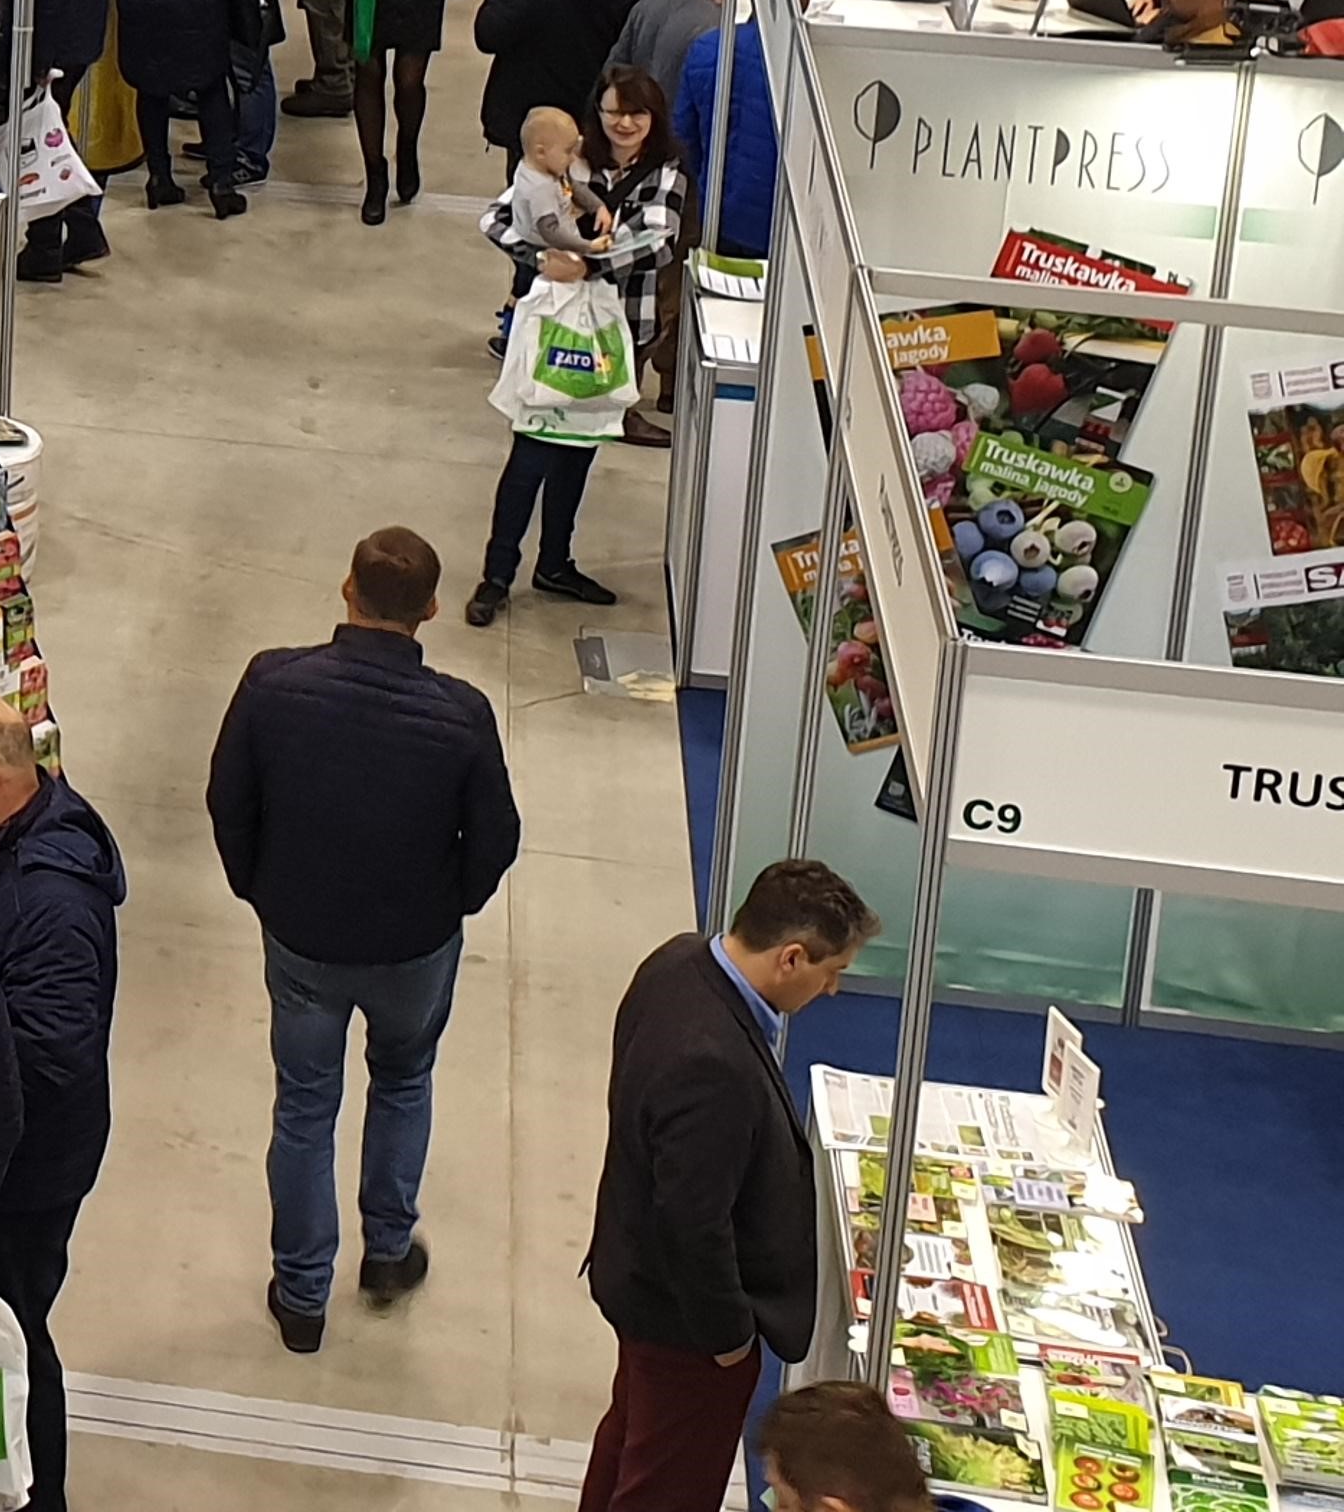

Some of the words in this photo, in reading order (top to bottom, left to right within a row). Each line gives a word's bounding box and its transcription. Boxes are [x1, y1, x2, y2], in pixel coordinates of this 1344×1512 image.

[911, 116, 1171, 193] PLANTPRESS
[1020, 241, 1138, 293] Truskawka
[979, 460, 1031, 486] malina
[1034, 478, 1085, 508] jagody
[984, 438, 1095, 492] Truskawka
[1222, 763, 1344, 811] TRUS
[963, 800, 1023, 834] C9
